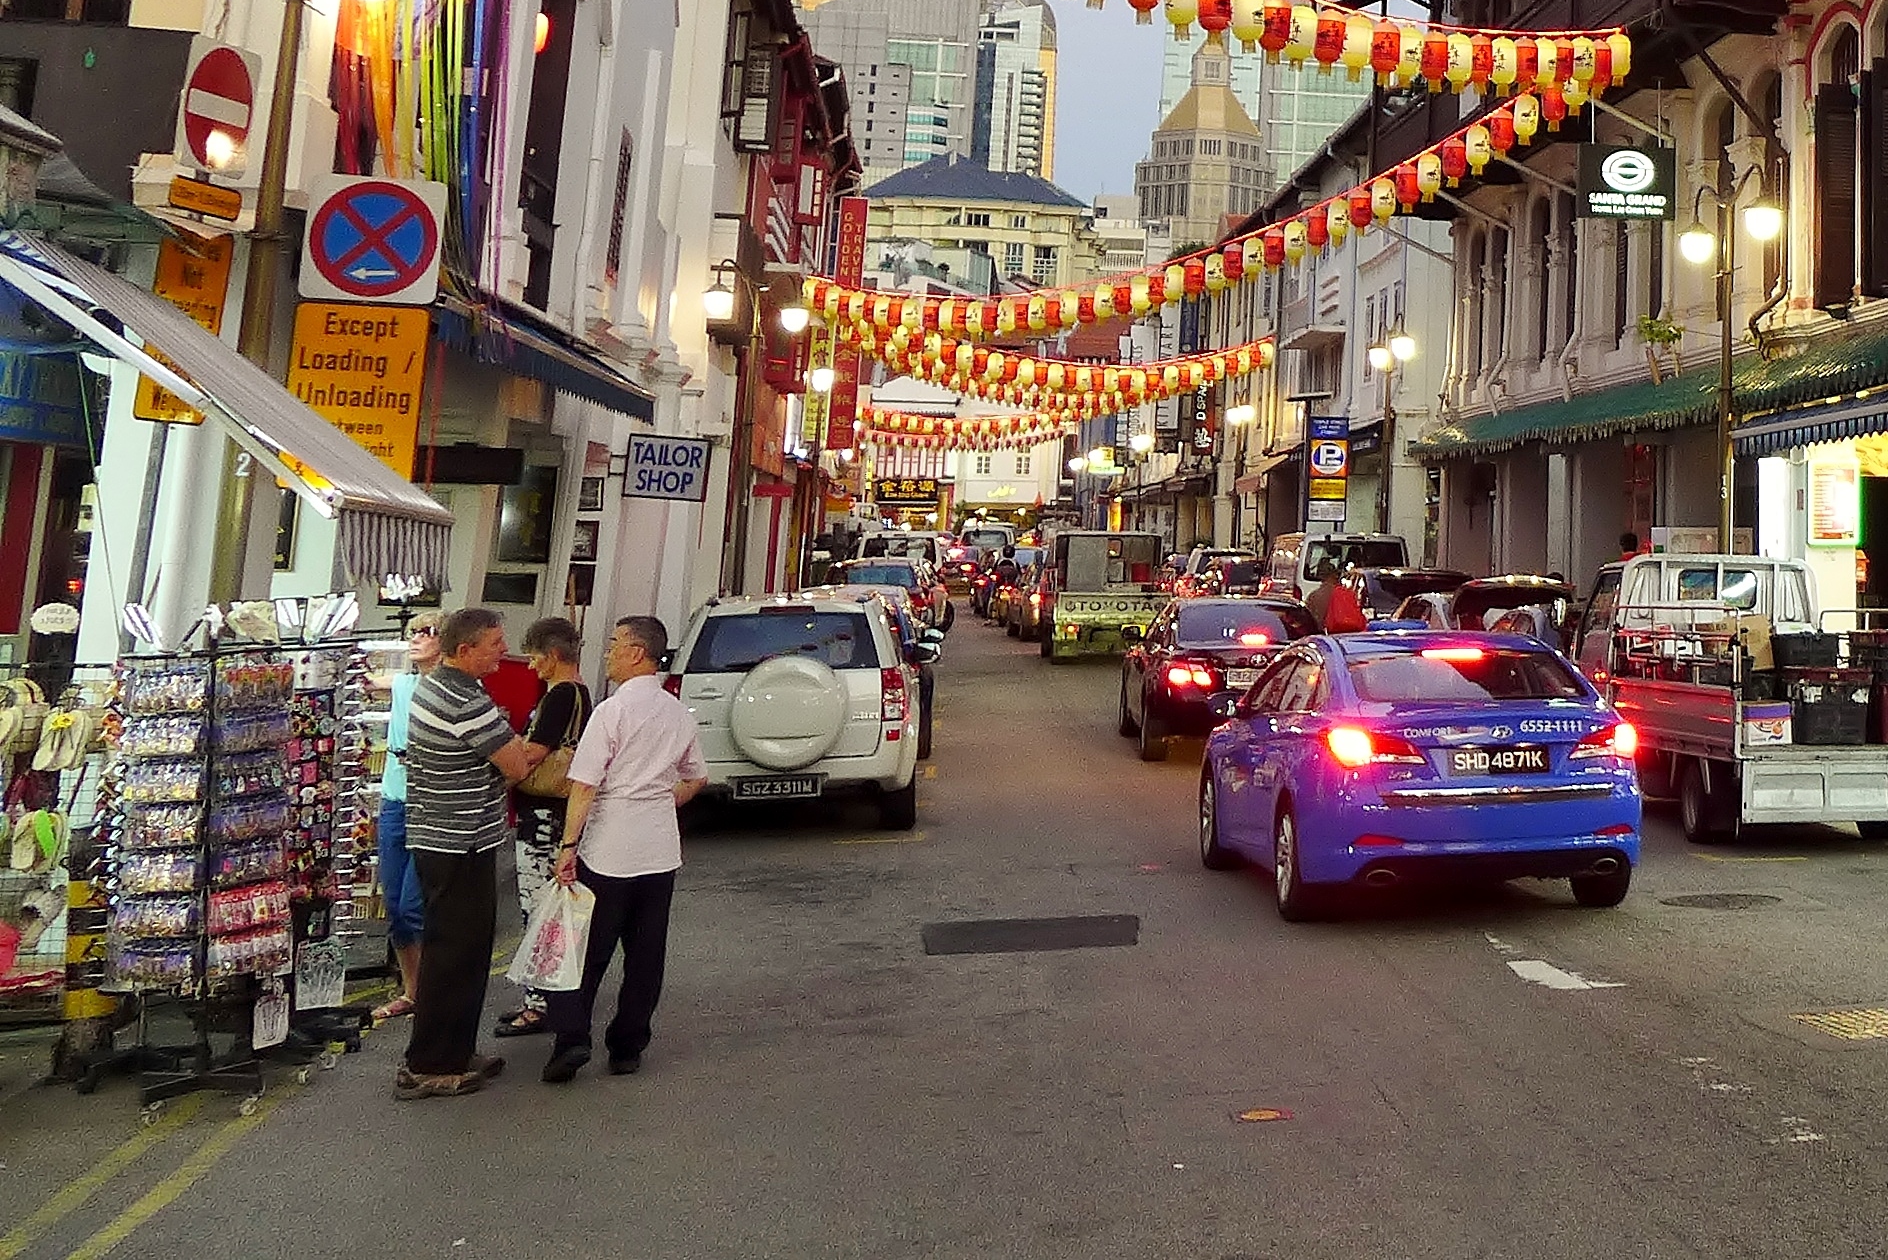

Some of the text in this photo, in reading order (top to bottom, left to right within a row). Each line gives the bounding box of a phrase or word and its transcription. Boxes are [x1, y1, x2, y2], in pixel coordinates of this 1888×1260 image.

[1589, 192, 1667, 207] SANTA GRAND
[840, 211, 854, 276] GOLDEN
[851, 223, 864, 288] TRAVEL
[325, 312, 400, 339] Except
[299, 347, 417, 378] Loading /
[297, 383, 411, 414] Unloading
[237, 453, 251, 477] 2
[634, 441, 703, 468] TAILOR
[635, 469, 694, 493] SHOP
[1720, 474, 1728, 499] 13
[1519, 719, 1584, 733] 6552-1111
